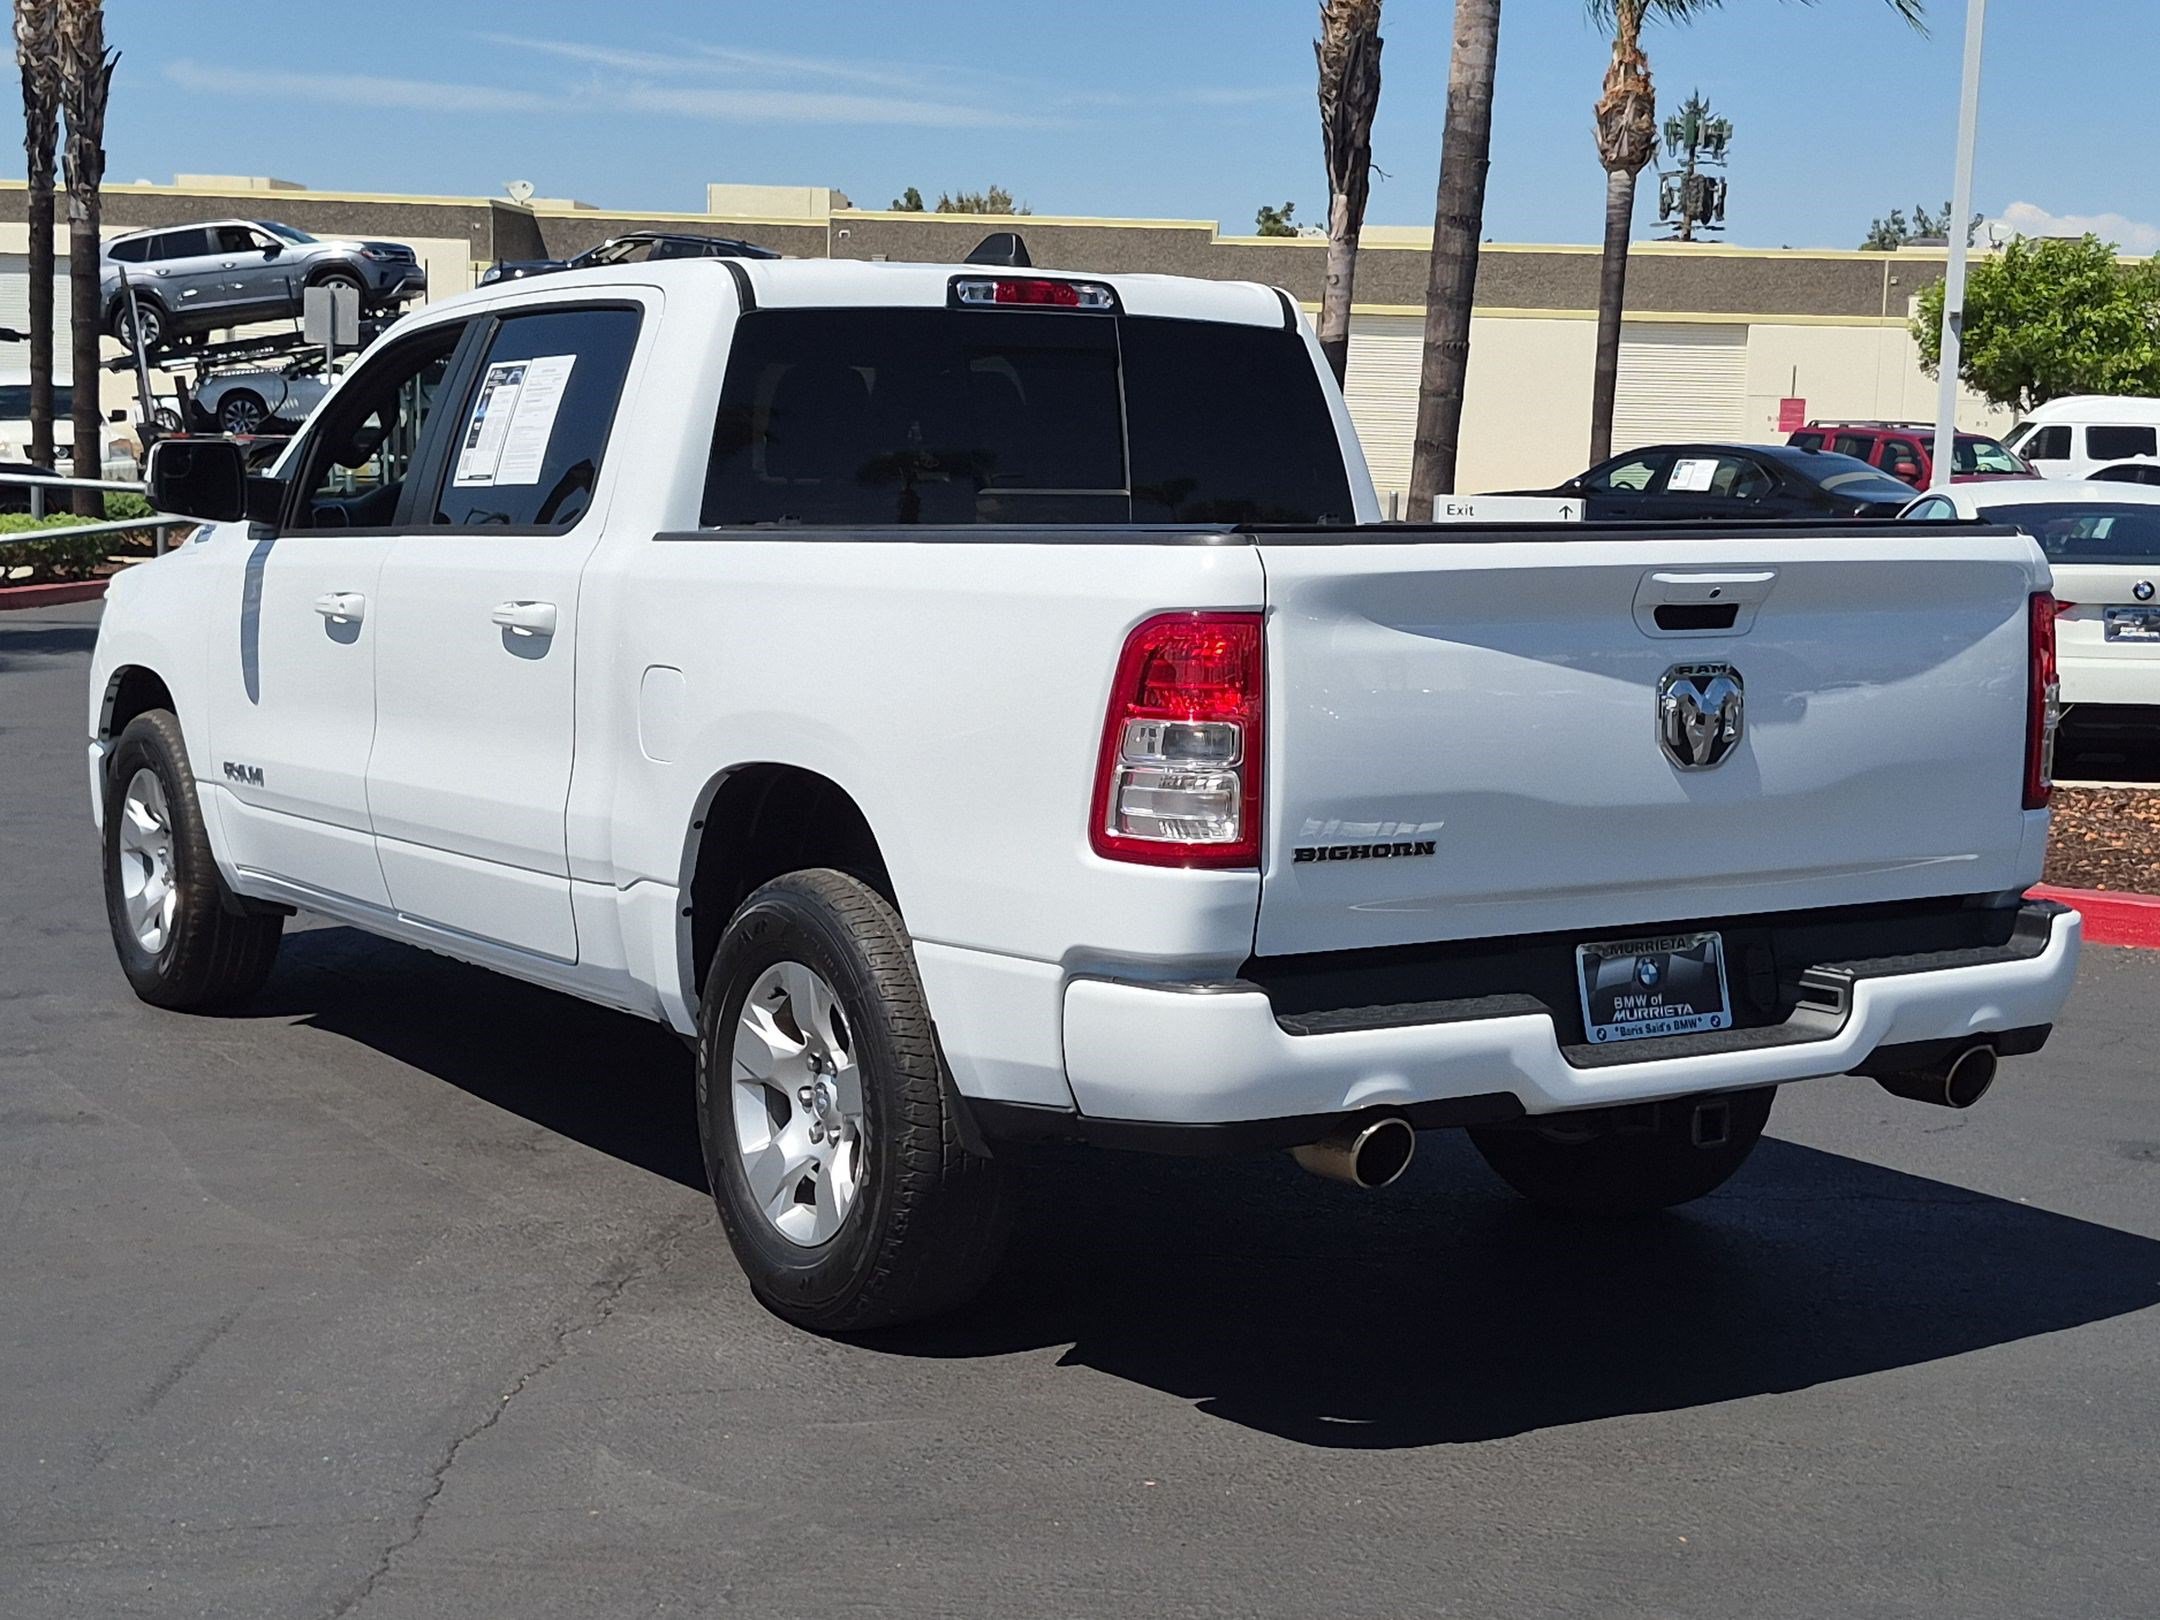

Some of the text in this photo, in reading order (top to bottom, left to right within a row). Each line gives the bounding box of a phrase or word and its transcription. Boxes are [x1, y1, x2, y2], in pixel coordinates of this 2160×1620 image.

[1447, 504, 1474, 516] Exit
[1676, 665, 1728, 675] RAM
[223, 761, 264, 788] RAM
[1293, 840, 1437, 863] BIGHORN
[1610, 938, 1687, 955] MURRIETA
[1614, 993, 1662, 1010] BMW of
[1612, 1003, 1694, 1022] MURRIETA
